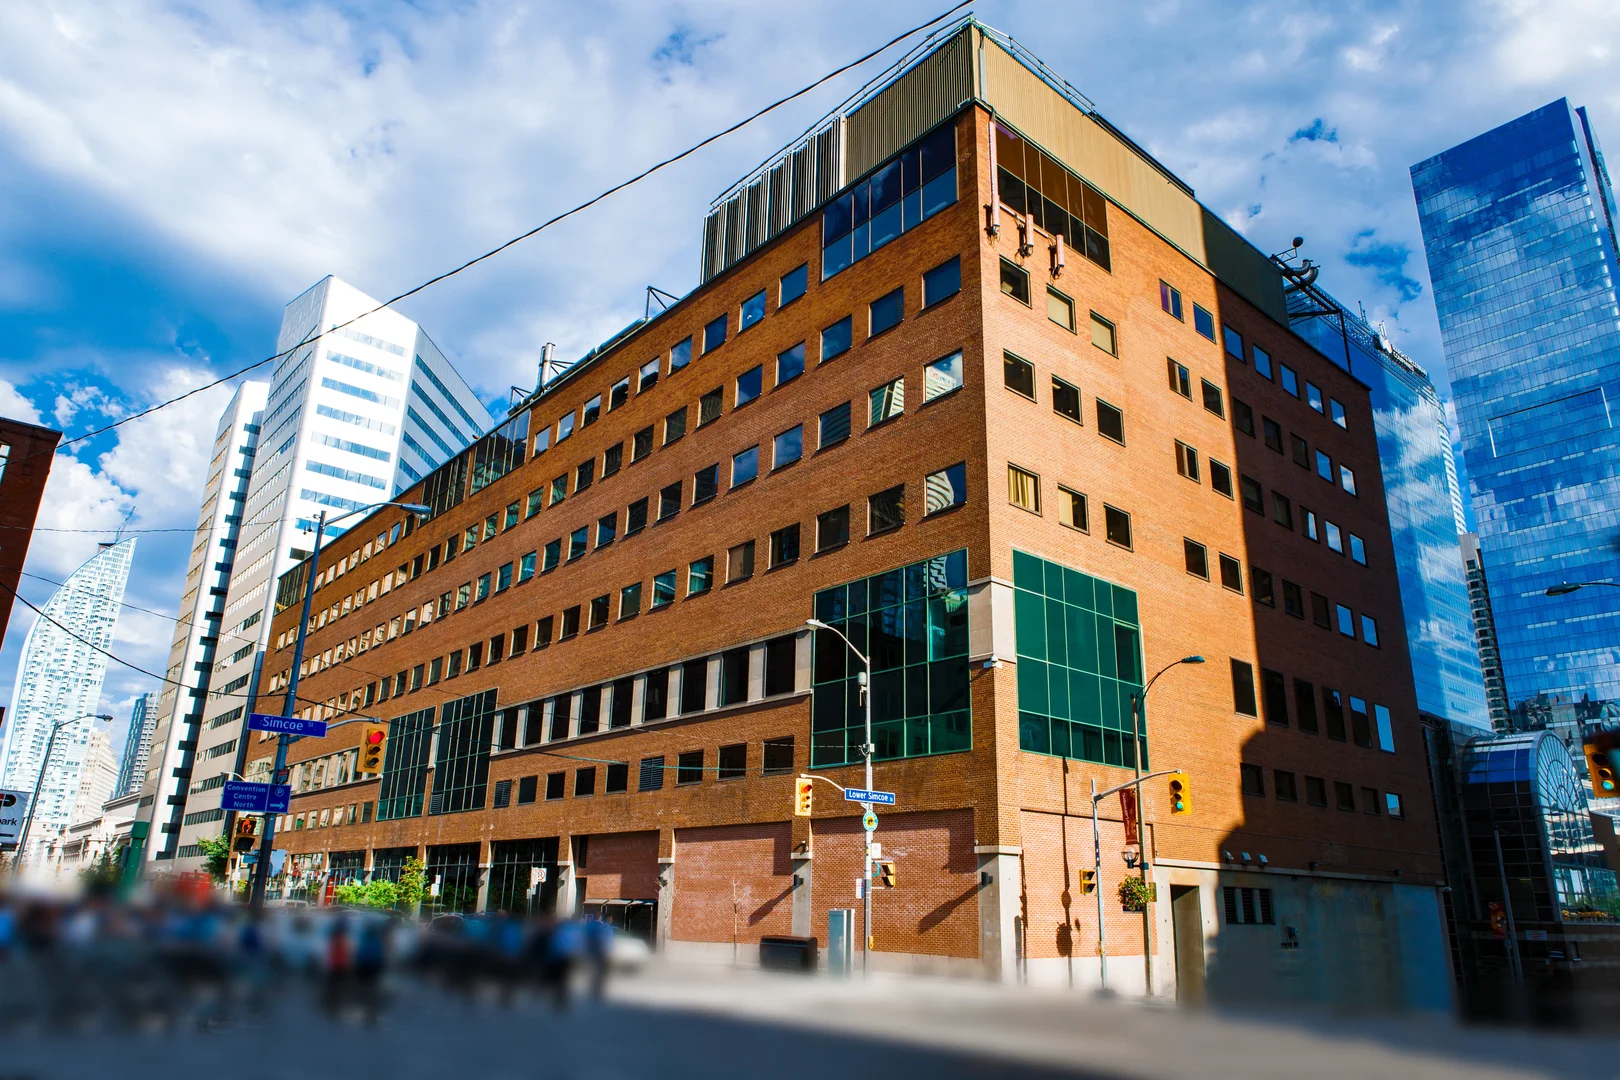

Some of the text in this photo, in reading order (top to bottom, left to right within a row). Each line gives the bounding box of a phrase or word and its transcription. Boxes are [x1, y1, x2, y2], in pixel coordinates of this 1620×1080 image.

[263, 716, 303, 731] Simcoe
[227, 784, 266, 793] Convention
[233, 792, 257, 800] Centre
[849, 790, 866, 799] Lower
[868, 792, 888, 801] Simcoe
[233, 801, 254, 809] North
[0, 817, 17, 826] ark
